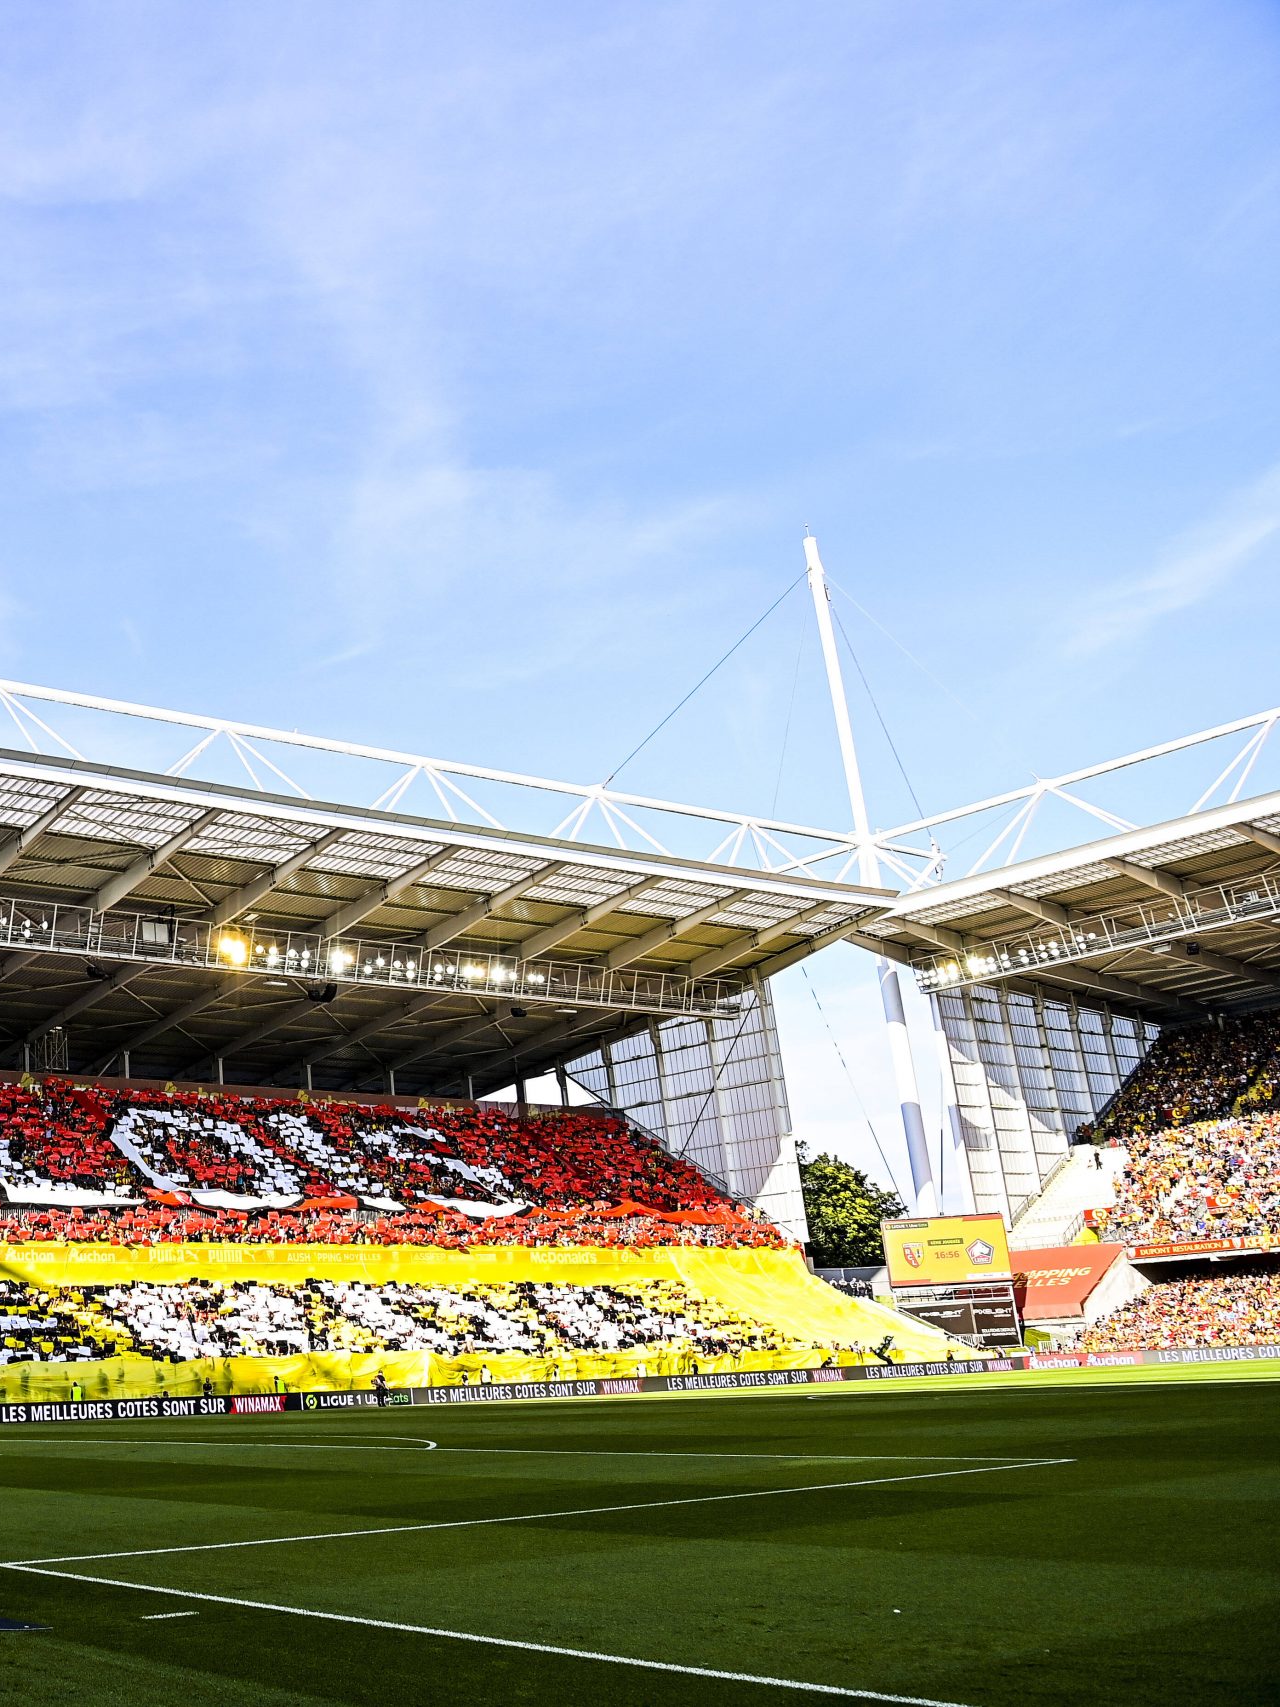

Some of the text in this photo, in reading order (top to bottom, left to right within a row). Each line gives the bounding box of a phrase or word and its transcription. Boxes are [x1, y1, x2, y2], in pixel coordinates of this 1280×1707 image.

[5, 1247, 54, 1262] Auchan
[68, 1248, 116, 1263] Auchan
[208, 1249, 242, 1263] PUMA
[934, 1250, 960, 1259] 16:56
[1140, 1242, 1221, 1256] DUPONT RESTAURATION
[530, 1251, 597, 1264] McDonald's
[1087, 1353, 1135, 1367] Auchan
[1158, 1350, 1179, 1363] LES
[1182, 1347, 1254, 1362] MEILLEURES
[865, 1358, 1013, 1379] LES MEILLEURES COTES SONT SUR WINAMAX
[1029, 1356, 1079, 1370] Auchan
[666, 1368, 844, 1391] LES MEILLEURES COTES SONT SUR WINAMAX
[427, 1379, 640, 1403] LES MEILLEURES COTES SONT SUR WINAMAX
[320, 1394, 354, 1407] LIGUE
[356, 1394, 362, 1406] 1
[1, 1395, 282, 1423] LES MEILLEURES COTES SONT SUR WINAMAX
